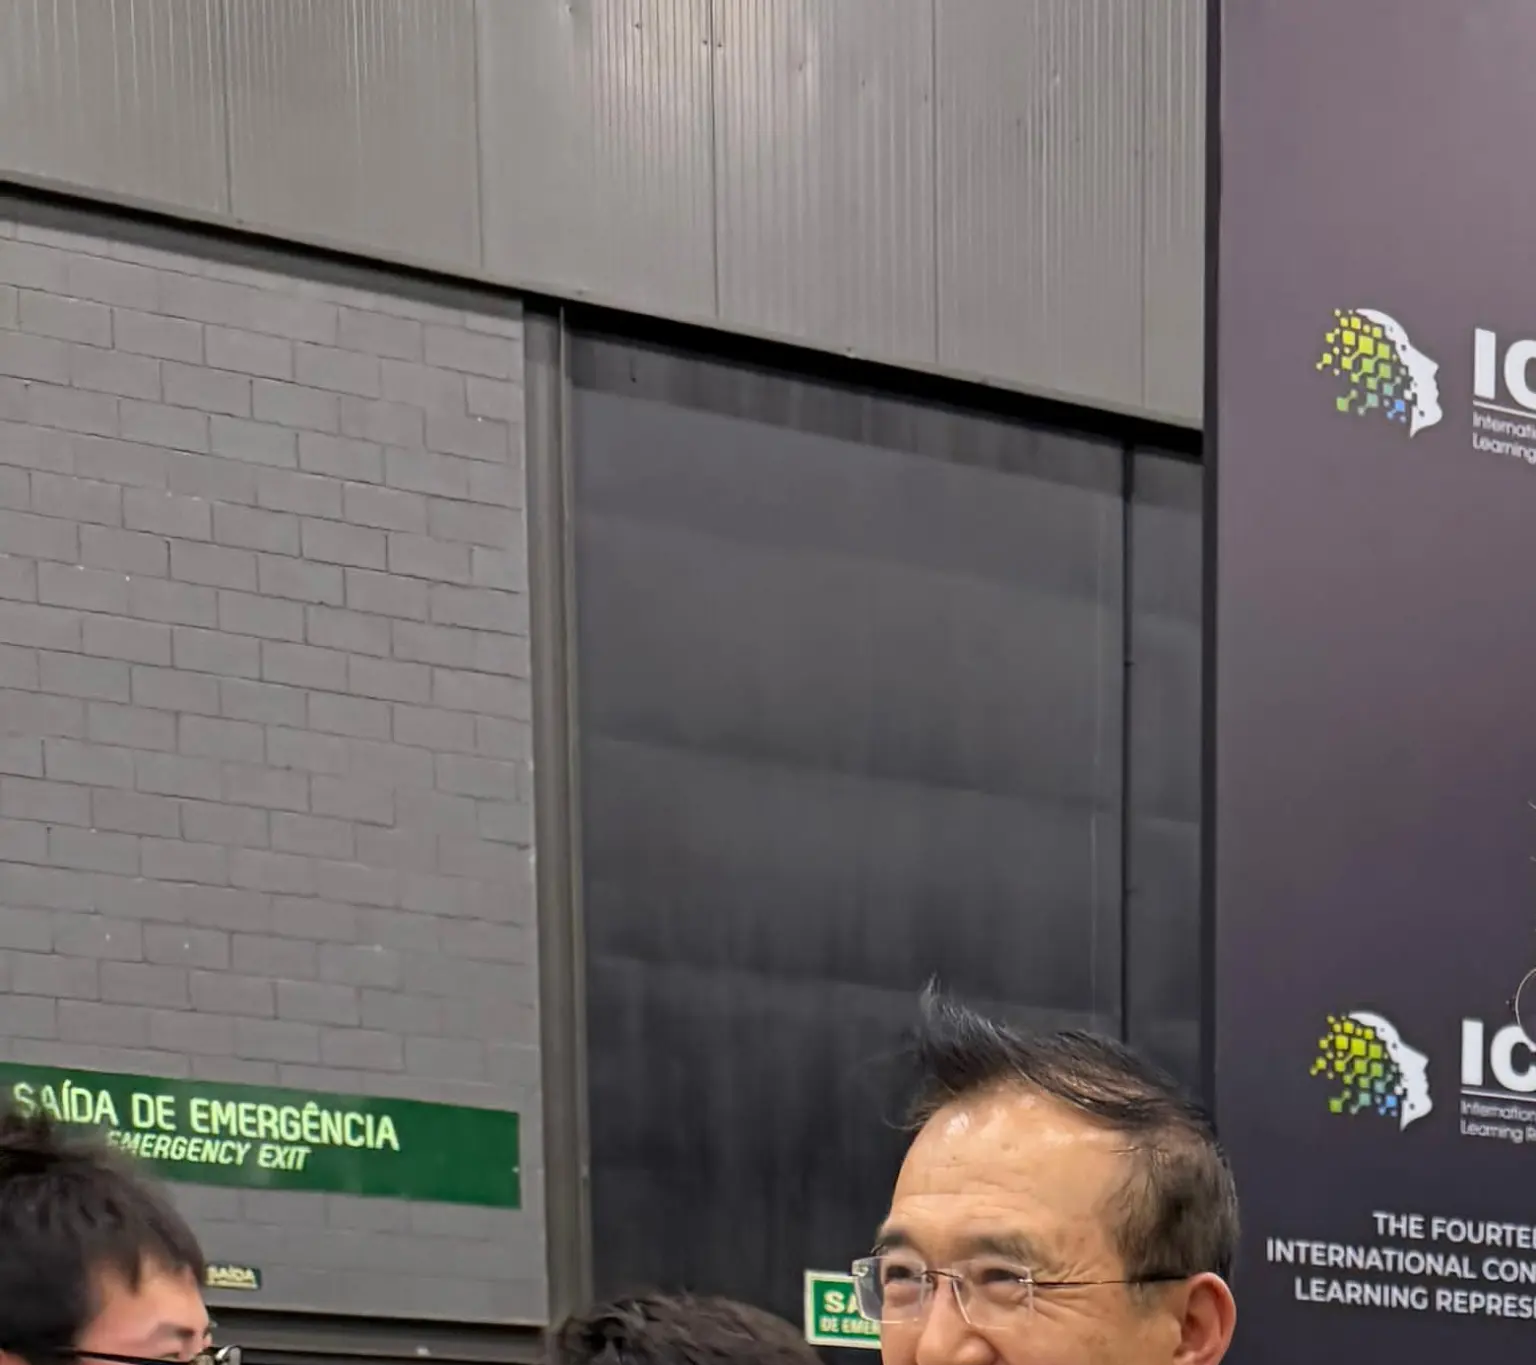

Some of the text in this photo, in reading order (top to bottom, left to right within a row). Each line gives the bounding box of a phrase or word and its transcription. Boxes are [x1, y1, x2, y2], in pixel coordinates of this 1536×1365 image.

[12, 1079, 401, 1153] SAÍDA DE EMERGÊNCIA
[1461, 1118, 1525, 1144] Learning
[106, 1129, 312, 1171] EMERGENCY EXIT
[1373, 1211, 1425, 1240] THE
[1266, 1237, 1477, 1281] INTERNATIONAL
[1294, 1278, 1428, 1311] LEARNING
